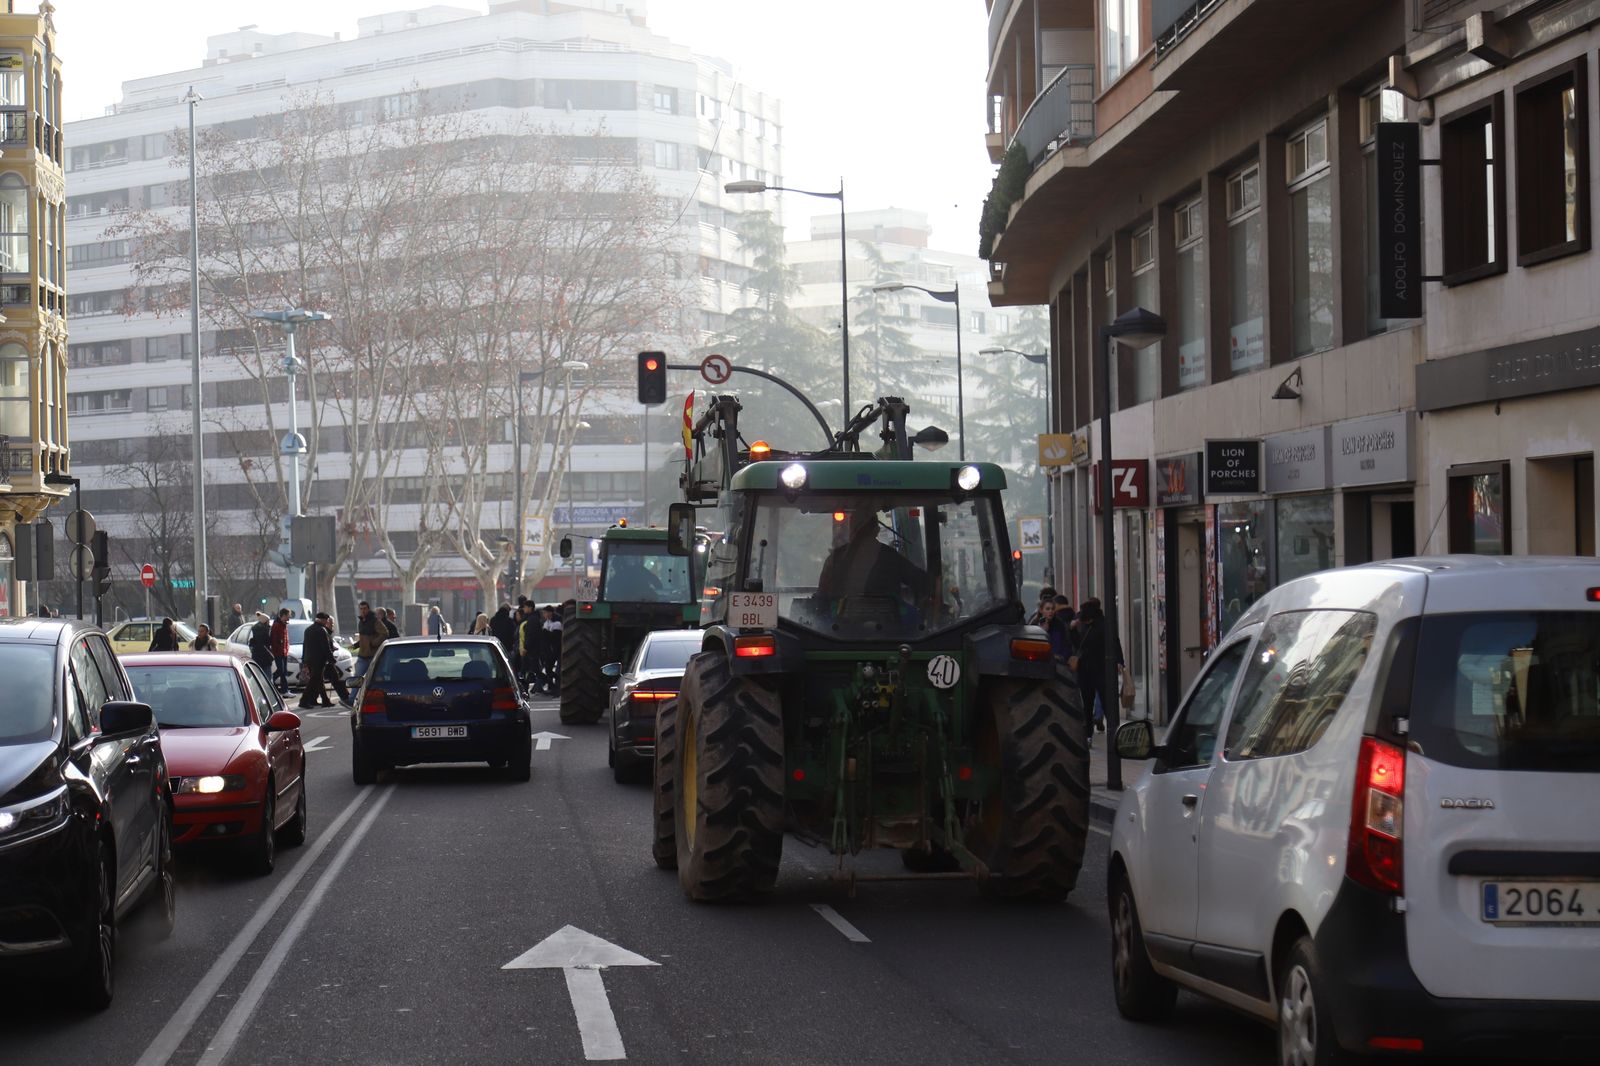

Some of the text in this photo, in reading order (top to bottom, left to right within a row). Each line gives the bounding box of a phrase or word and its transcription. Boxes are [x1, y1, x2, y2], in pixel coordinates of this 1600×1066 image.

[1393, 142, 1408, 299] ADOLFO DOMINGUEZ
[1342, 431, 1395, 456] LION OF PORCHES
[1221, 448, 1245, 457] LION
[1226, 459, 1240, 468] OF
[1210, 469, 1256, 478] PORCHES
[732, 594, 773, 607] E 3439
[742, 613, 764, 625] BBL
[930, 657, 956, 686] 40
[418, 727, 442, 737] 5891
[1440, 798, 1495, 810] DACIA
[1505, 887, 1585, 916] 2064
